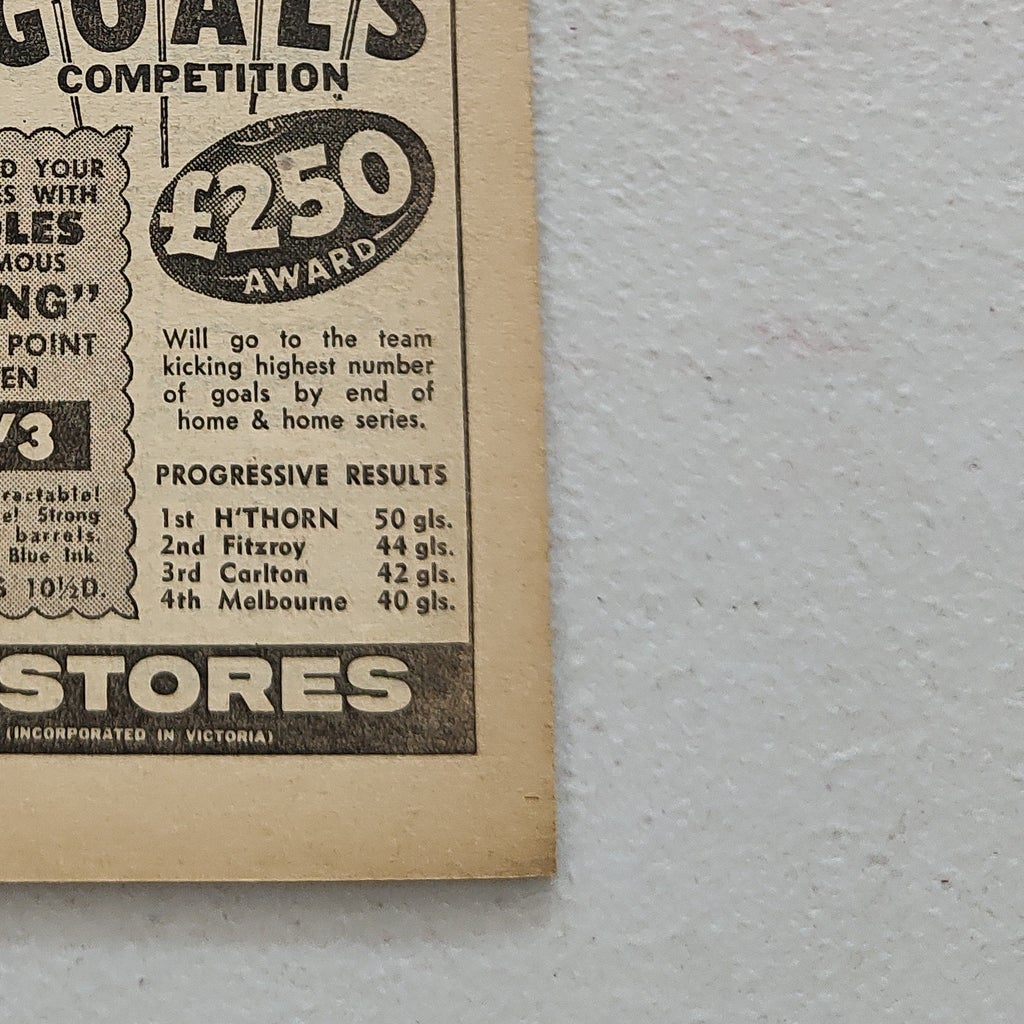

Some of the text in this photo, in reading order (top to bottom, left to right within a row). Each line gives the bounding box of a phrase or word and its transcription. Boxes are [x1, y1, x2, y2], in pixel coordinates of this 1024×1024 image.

[57, 62, 349, 94] COMPETITION
[34, 158, 104, 178] YOUR
[32, 184, 97, 204] WITH
[159, 128, 412, 260] £250
[243, 238, 377, 294] AWARD
[8, 332, 96, 356] POINT
[163, 326, 432, 353] Will go to the team
[163, 353, 435, 380] kicking highest number
[163, 380, 435, 407] of goals by end of
[178, 407, 426, 430] home & home series.
[156, 464, 448, 486] PROGRESSIVE RESULTS
[37, 505, 100, 525] Strong
[161, 506, 453, 533] 1st H'THORN 50 gls.
[9, 547, 51, 564] Blue
[160, 534, 454, 560] 2nd Fitzroy 44 gls.
[161, 561, 456, 587] 3rd Carlton 42 gls.
[160, 588, 456, 615] 4th Melbourne 40 gls.
[6, 726, 146, 741] (INCORPORATED
[157, 728, 174, 741] IN
[186, 729, 273, 743] VICTORIA)
